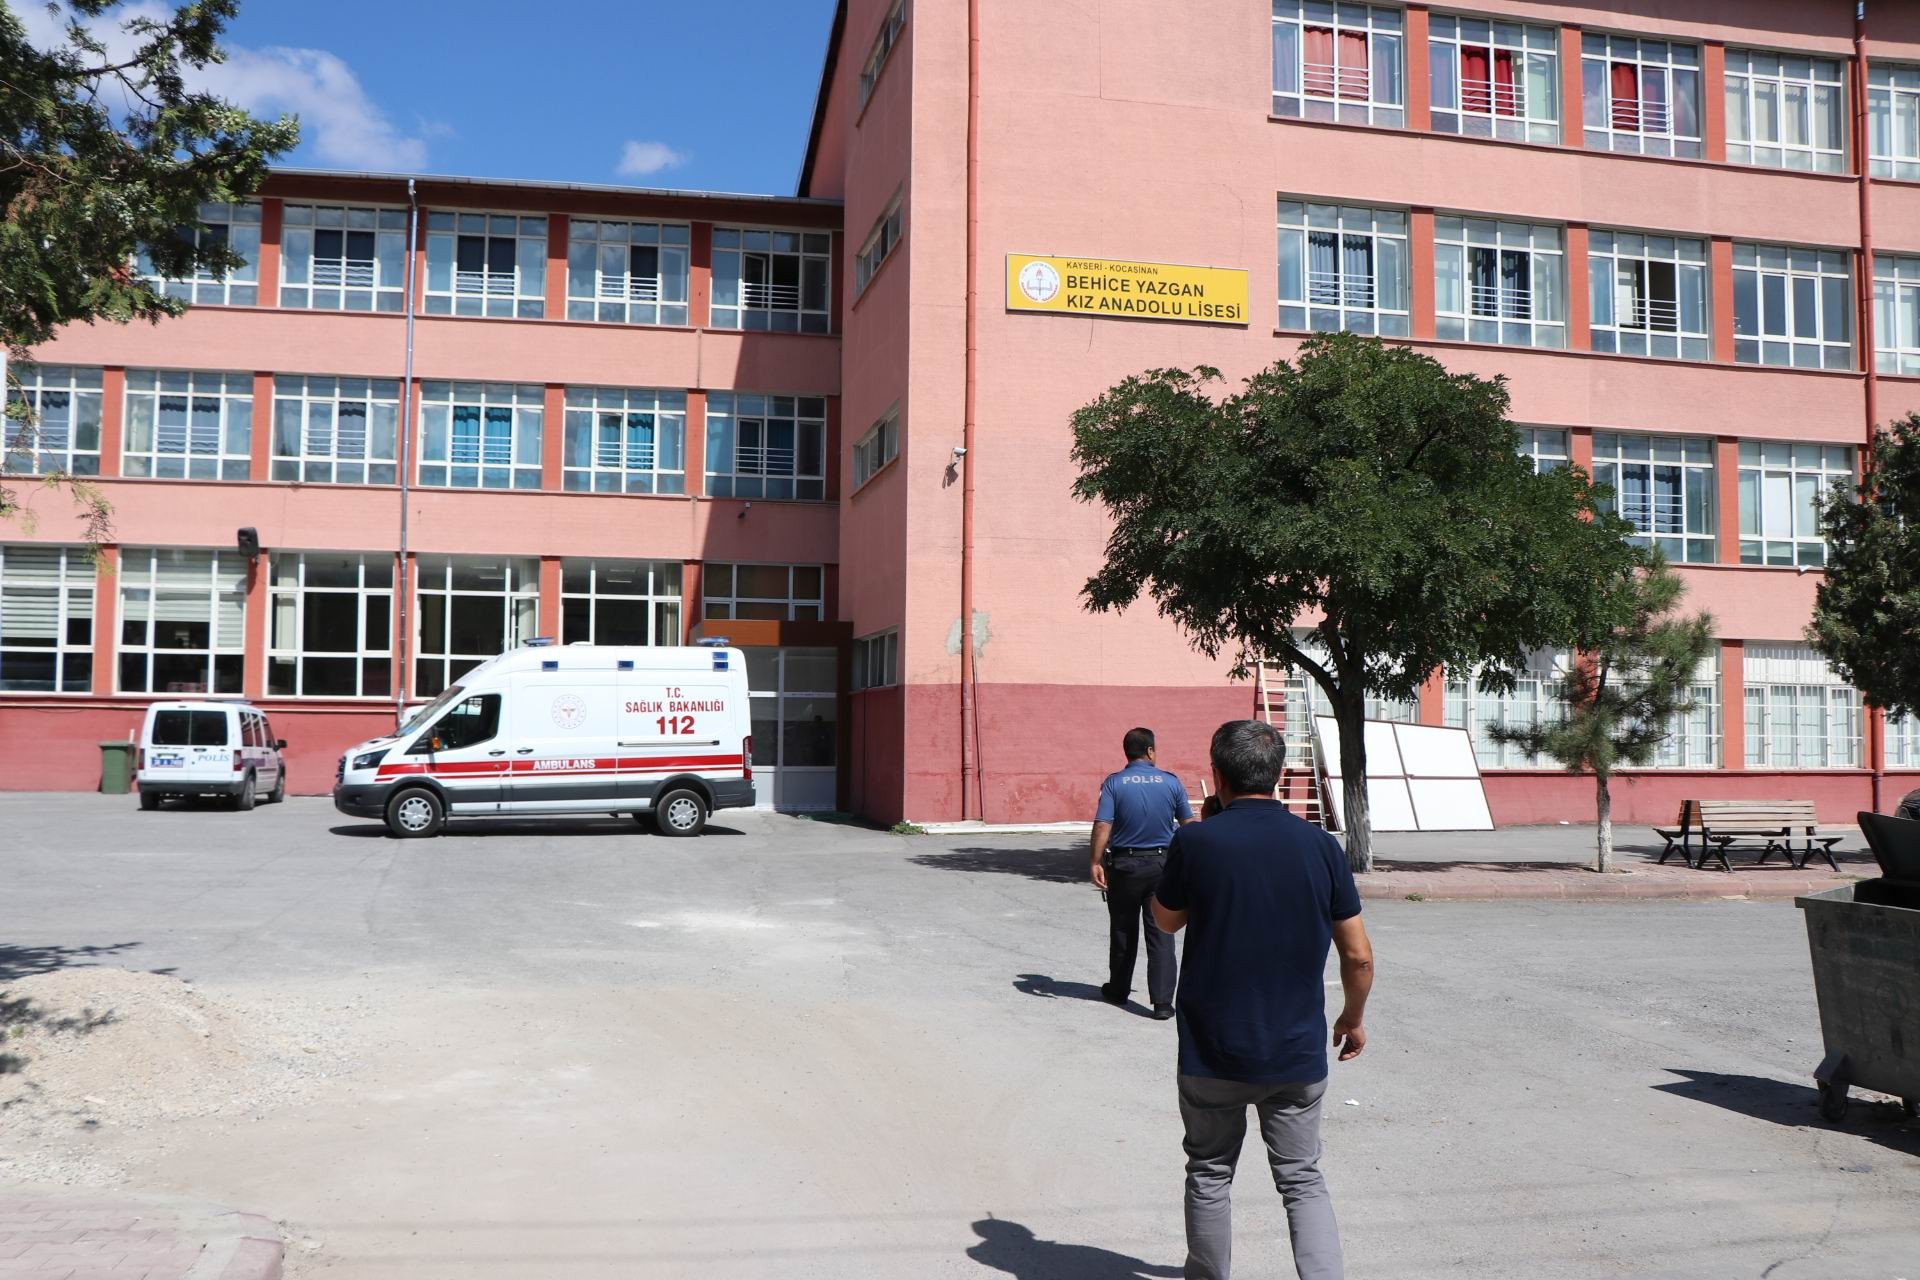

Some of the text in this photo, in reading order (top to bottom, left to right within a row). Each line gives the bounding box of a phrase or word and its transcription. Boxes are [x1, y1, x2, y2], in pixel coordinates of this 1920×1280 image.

[1066, 261, 1103, 271] KAYSERİ
[1109, 264, 1158, 275] KOCASİNAN
[1066, 275, 1205, 297] BEHİCE YAZGAN
[1066, 294, 1241, 319] KIZ ANADOLU LİSESİ
[665, 687, 685, 698] T.C.
[625, 699, 724, 713] SAĞLIK BAKANLIĞI
[656, 715, 695, 735] 112
[533, 759, 596, 770] AMBULANS
